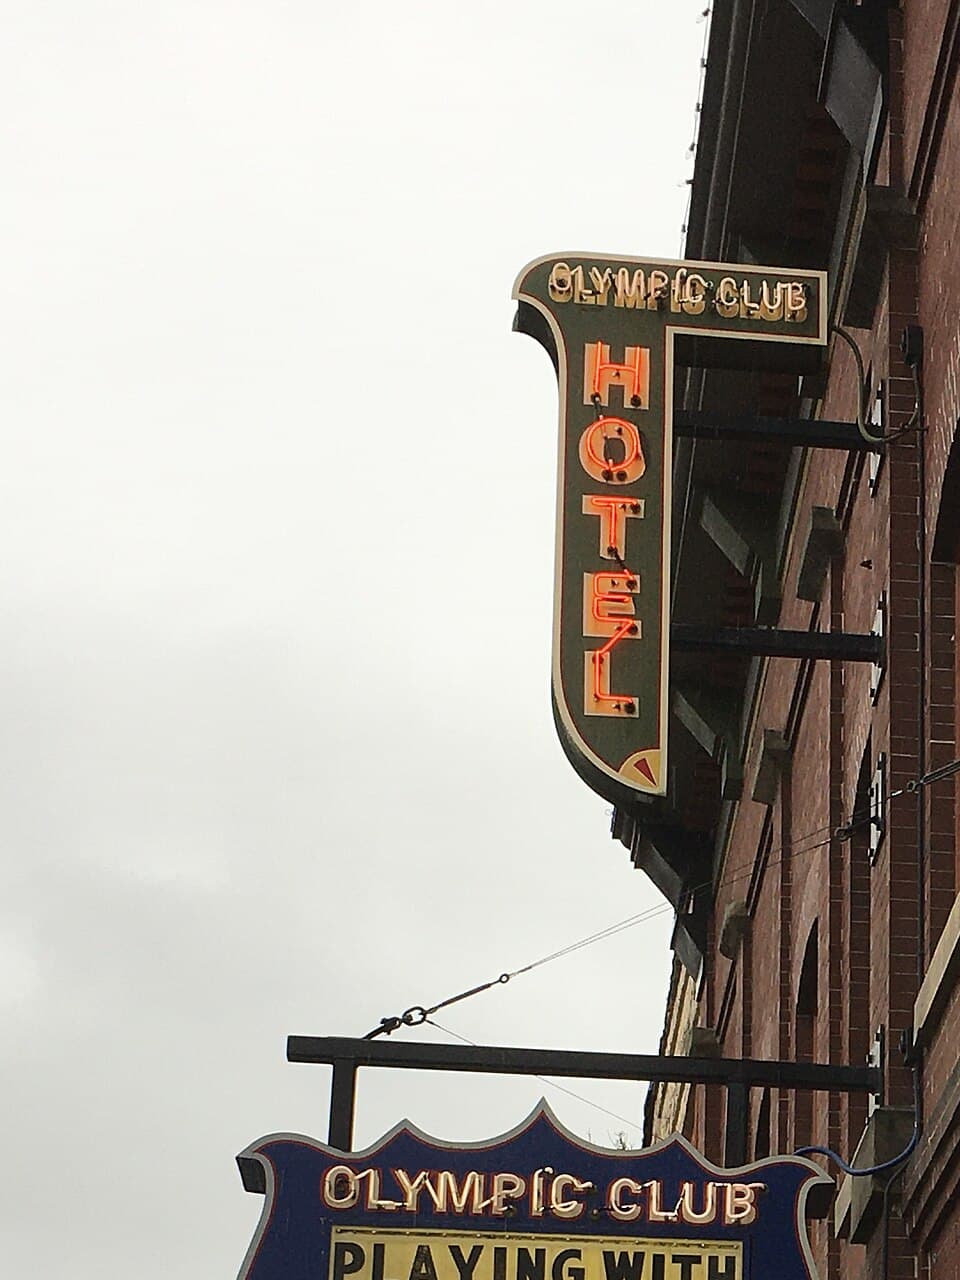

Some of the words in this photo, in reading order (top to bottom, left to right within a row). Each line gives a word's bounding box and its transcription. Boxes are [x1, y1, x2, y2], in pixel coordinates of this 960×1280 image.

[548, 261, 709, 316] OLYMPIC
[716, 275, 808, 323] CLUB
[578, 340, 651, 718] HOTEL
[323, 1164, 597, 1217] OLYMPIC
[609, 1177, 768, 1224] CLUB
